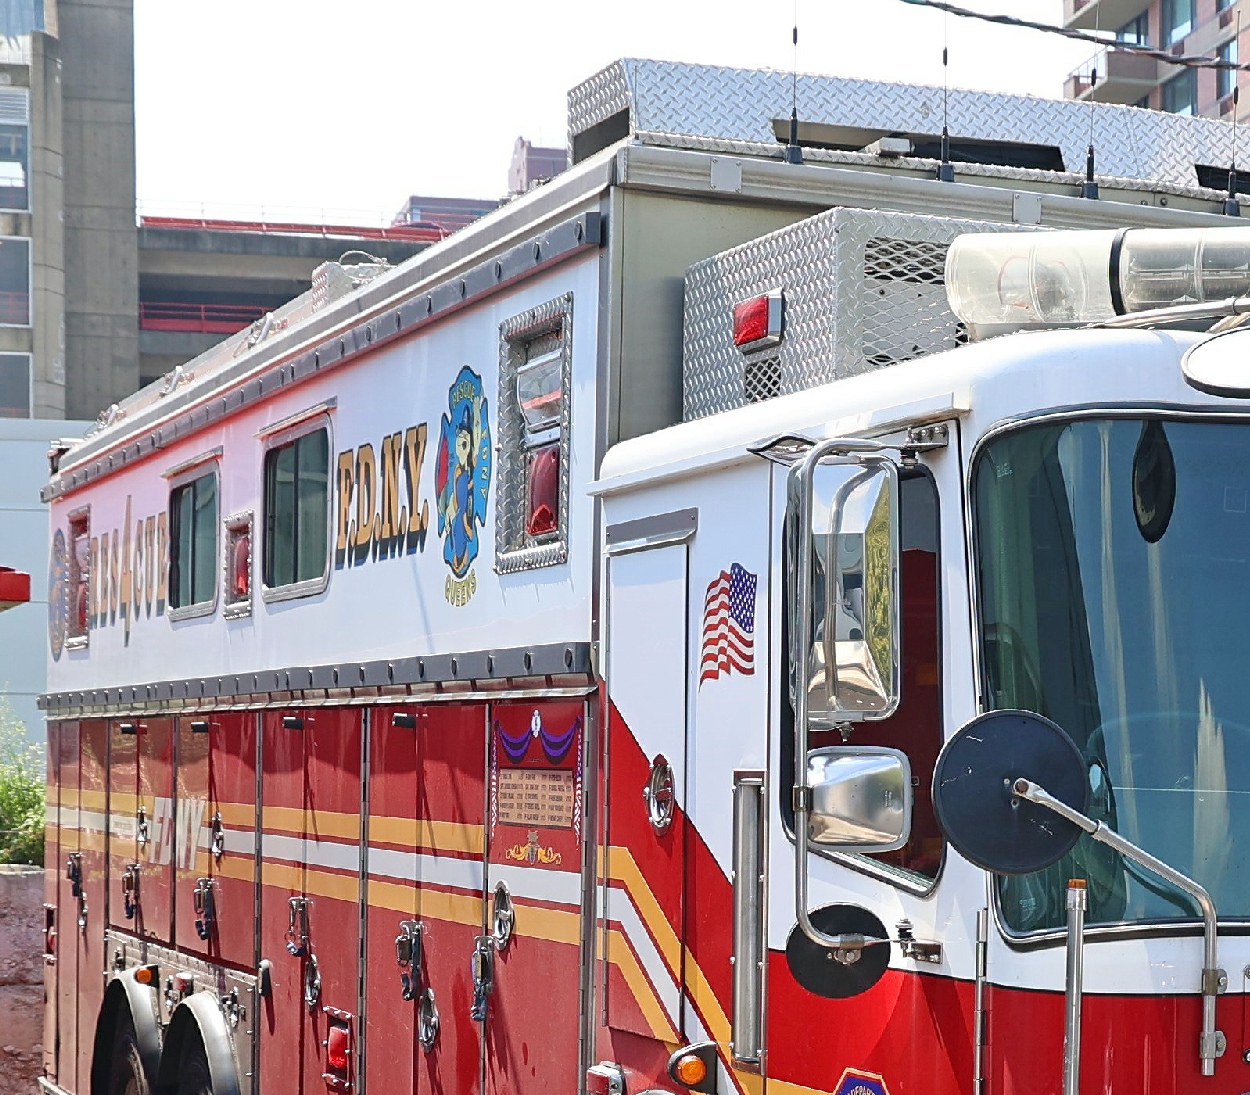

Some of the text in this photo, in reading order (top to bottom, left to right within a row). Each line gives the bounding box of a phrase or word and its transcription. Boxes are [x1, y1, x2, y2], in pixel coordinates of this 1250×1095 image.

[452, 380, 475, 409] RESCUE
[336, 423, 429, 564] F.D.N.Y.
[445, 568, 477, 607] QUEENS
[148, 796, 207, 871] FDNY
